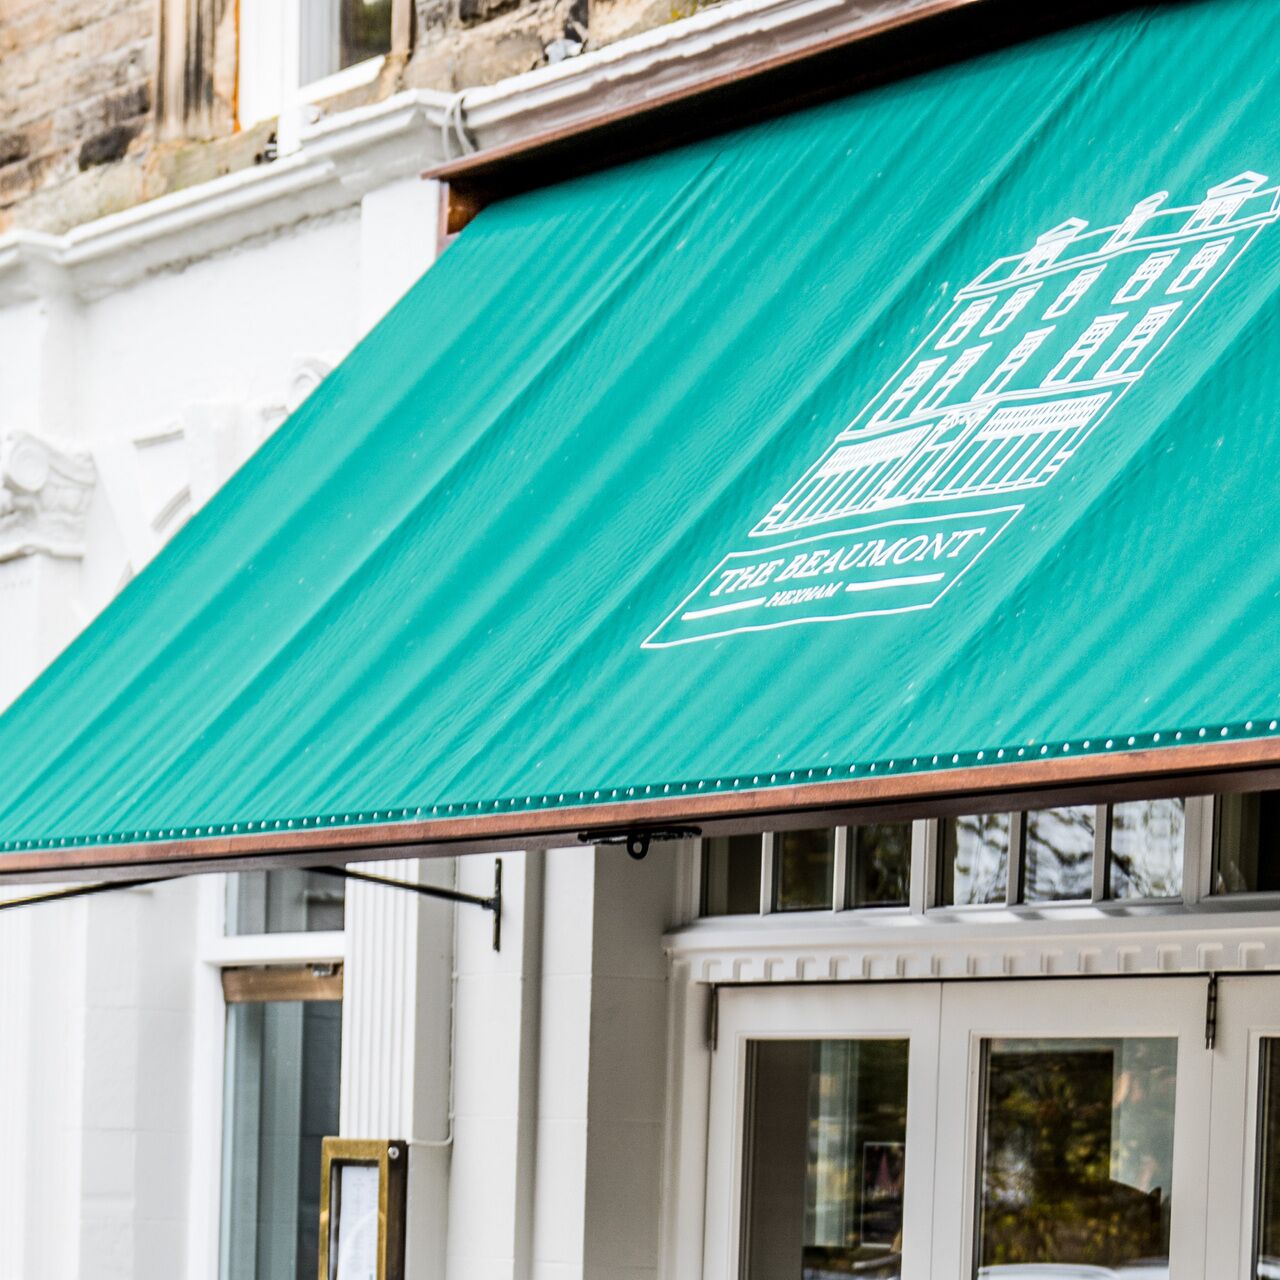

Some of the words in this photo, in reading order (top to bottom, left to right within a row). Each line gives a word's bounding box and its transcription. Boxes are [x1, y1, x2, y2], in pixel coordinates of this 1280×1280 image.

[710, 559, 784, 597] THE
[774, 528, 987, 582] BEAUMONT
[764, 581, 844, 608] HEXHAM
